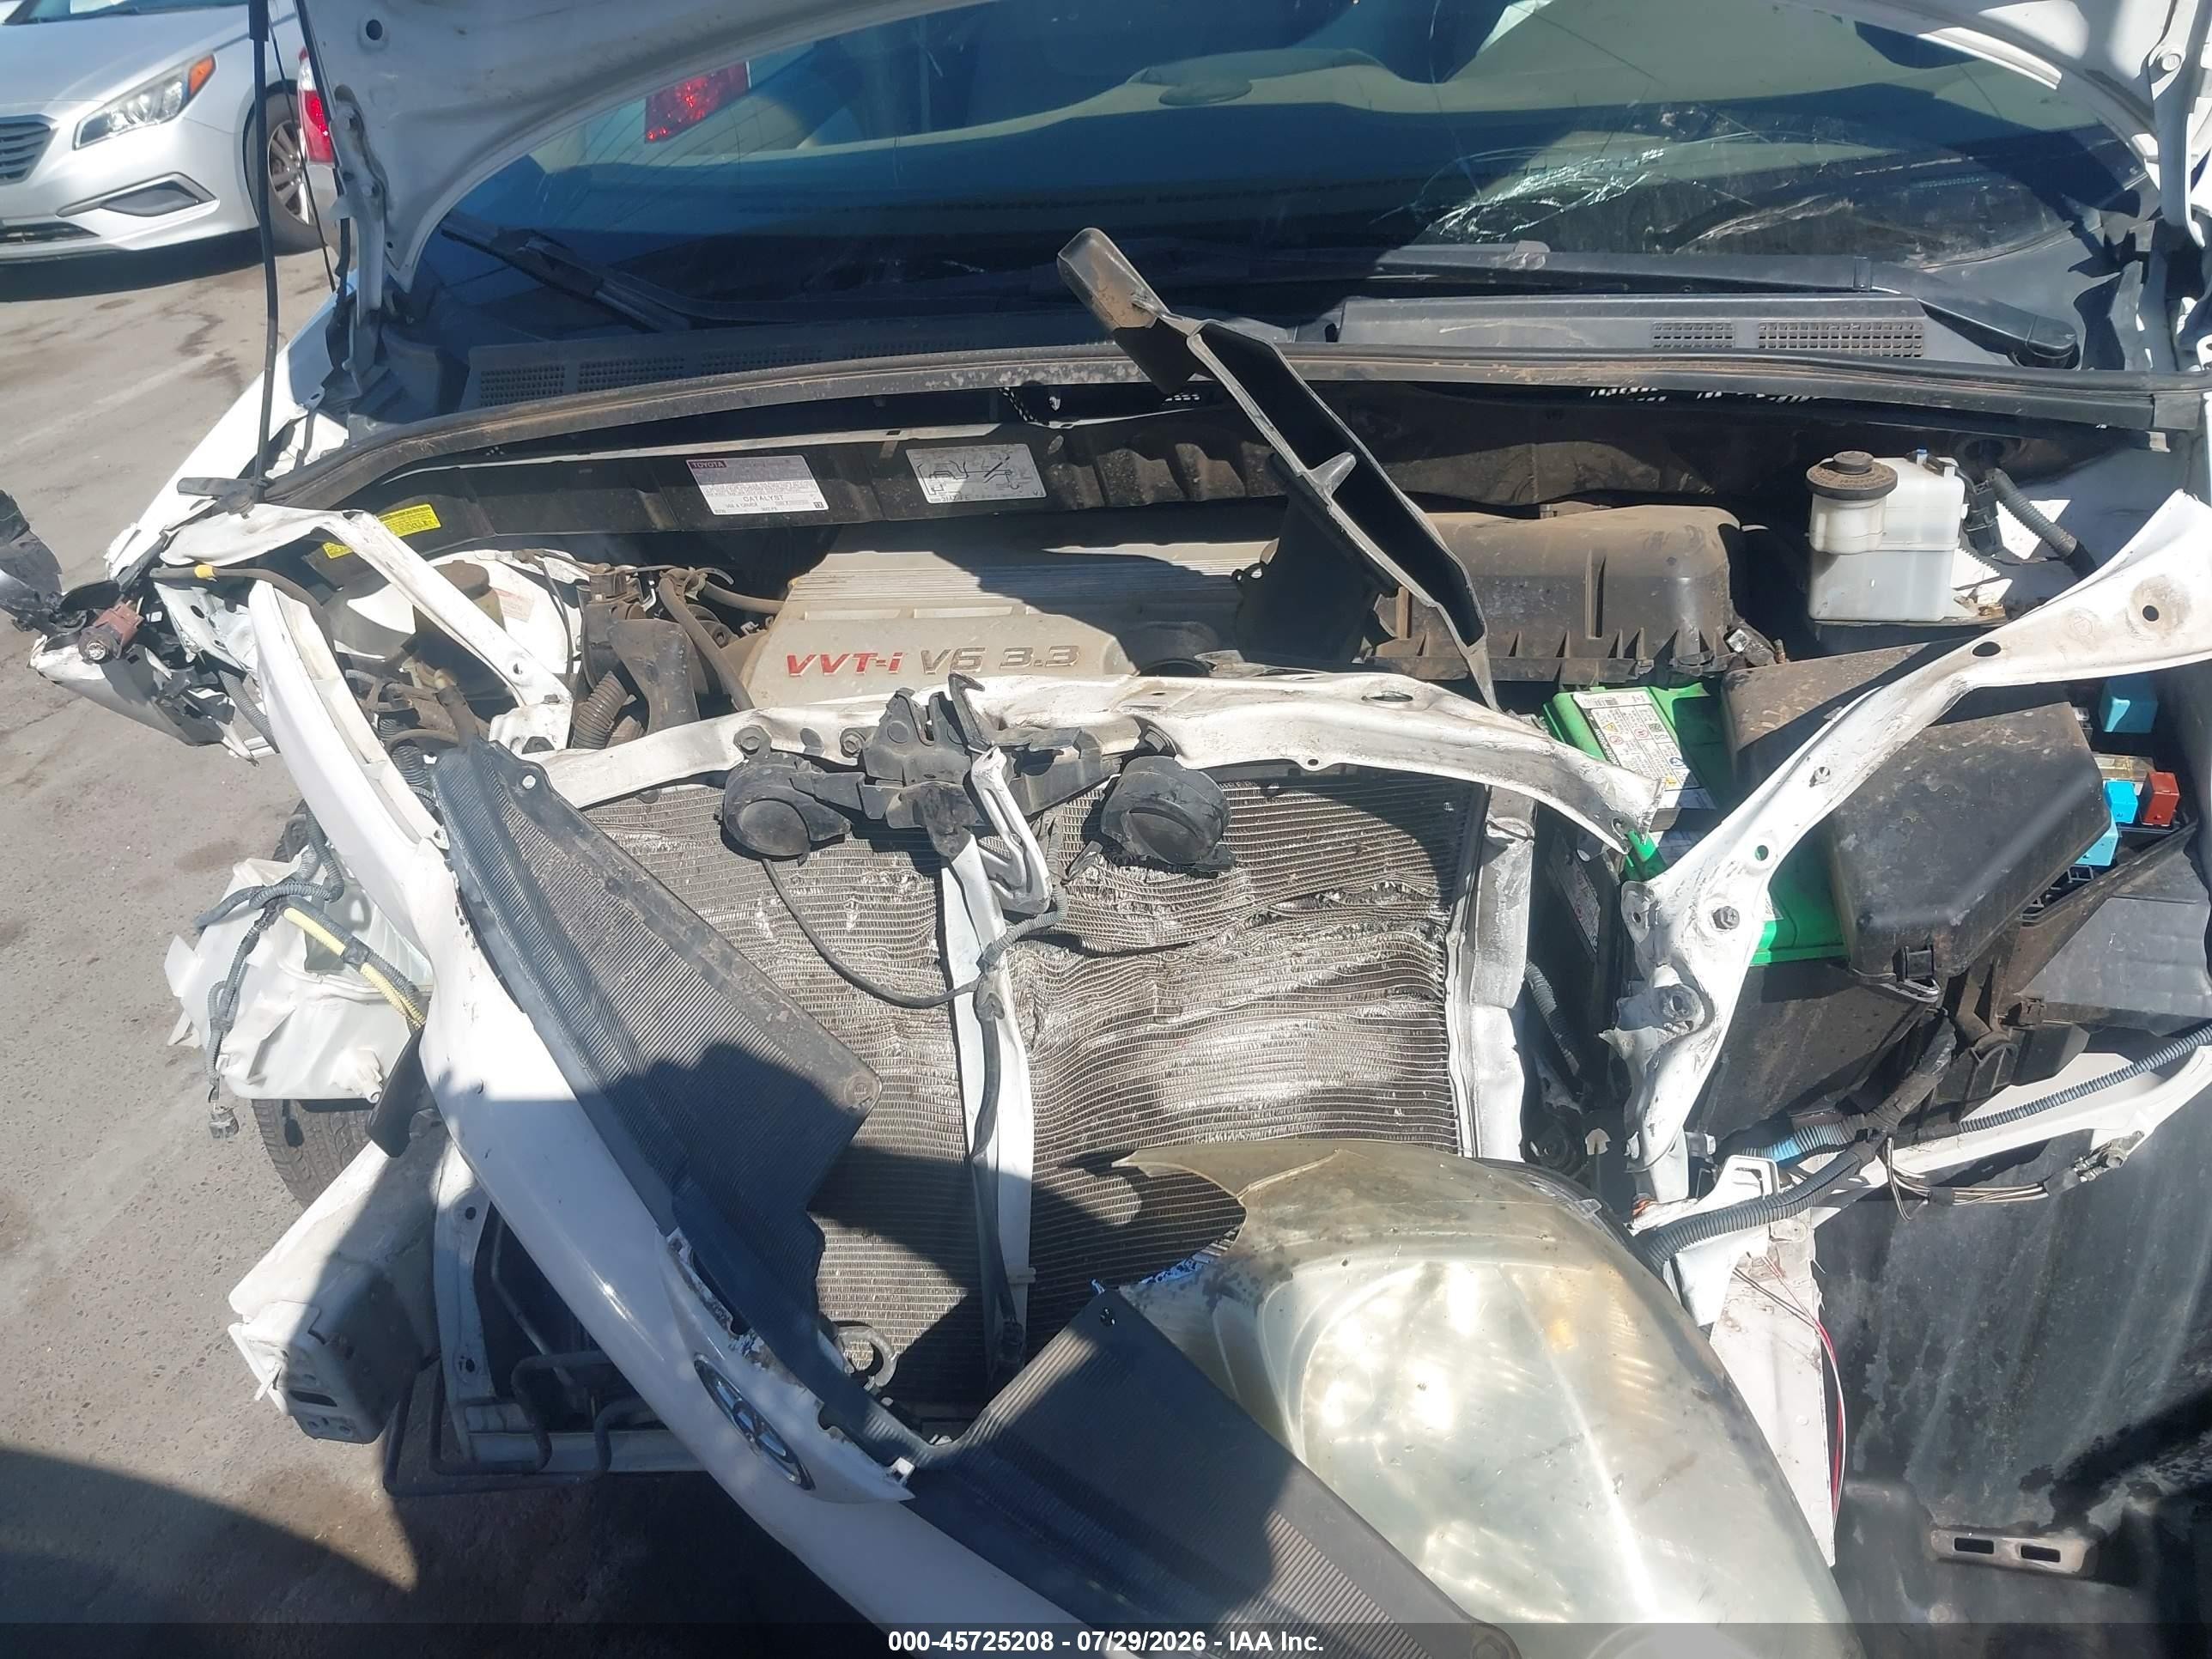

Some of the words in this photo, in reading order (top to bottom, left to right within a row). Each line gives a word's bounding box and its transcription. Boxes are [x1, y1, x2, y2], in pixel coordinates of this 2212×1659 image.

[786, 652, 905, 677] VVT-i
[920, 646, 986, 676] V6
[1000, 645, 1079, 671] 3.3
